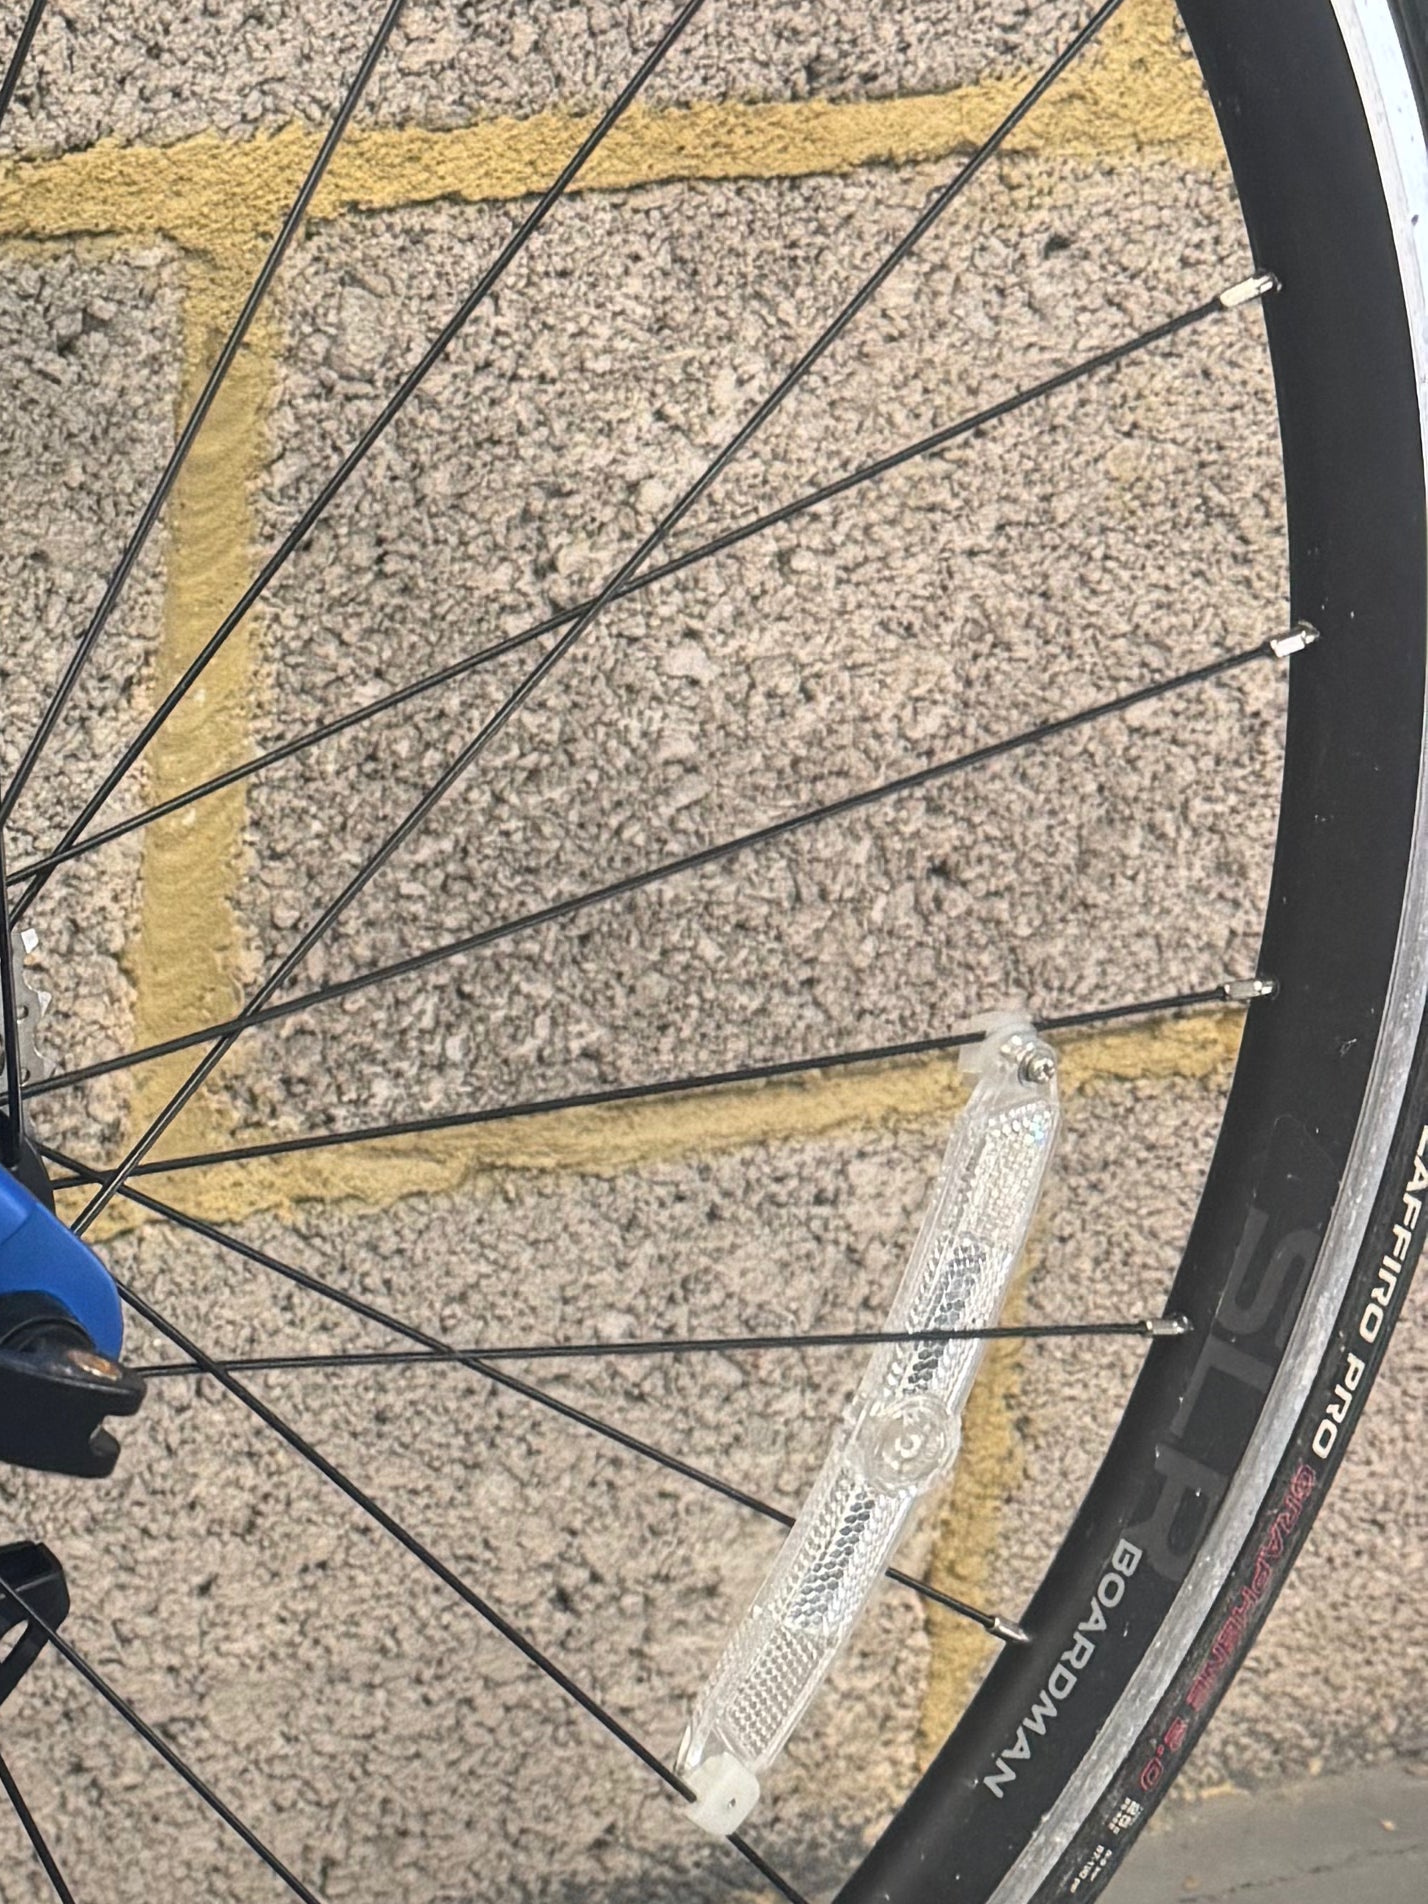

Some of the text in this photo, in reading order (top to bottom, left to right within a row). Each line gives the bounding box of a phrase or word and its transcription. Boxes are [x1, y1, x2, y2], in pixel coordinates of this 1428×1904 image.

[1126, 1206, 1322, 1583] SLR
[1312, 1353, 1366, 1459] PRO
[983, 1537, 1143, 1798] BOARDMAN
[1187, 1464, 1316, 1713] GRAPHENE
